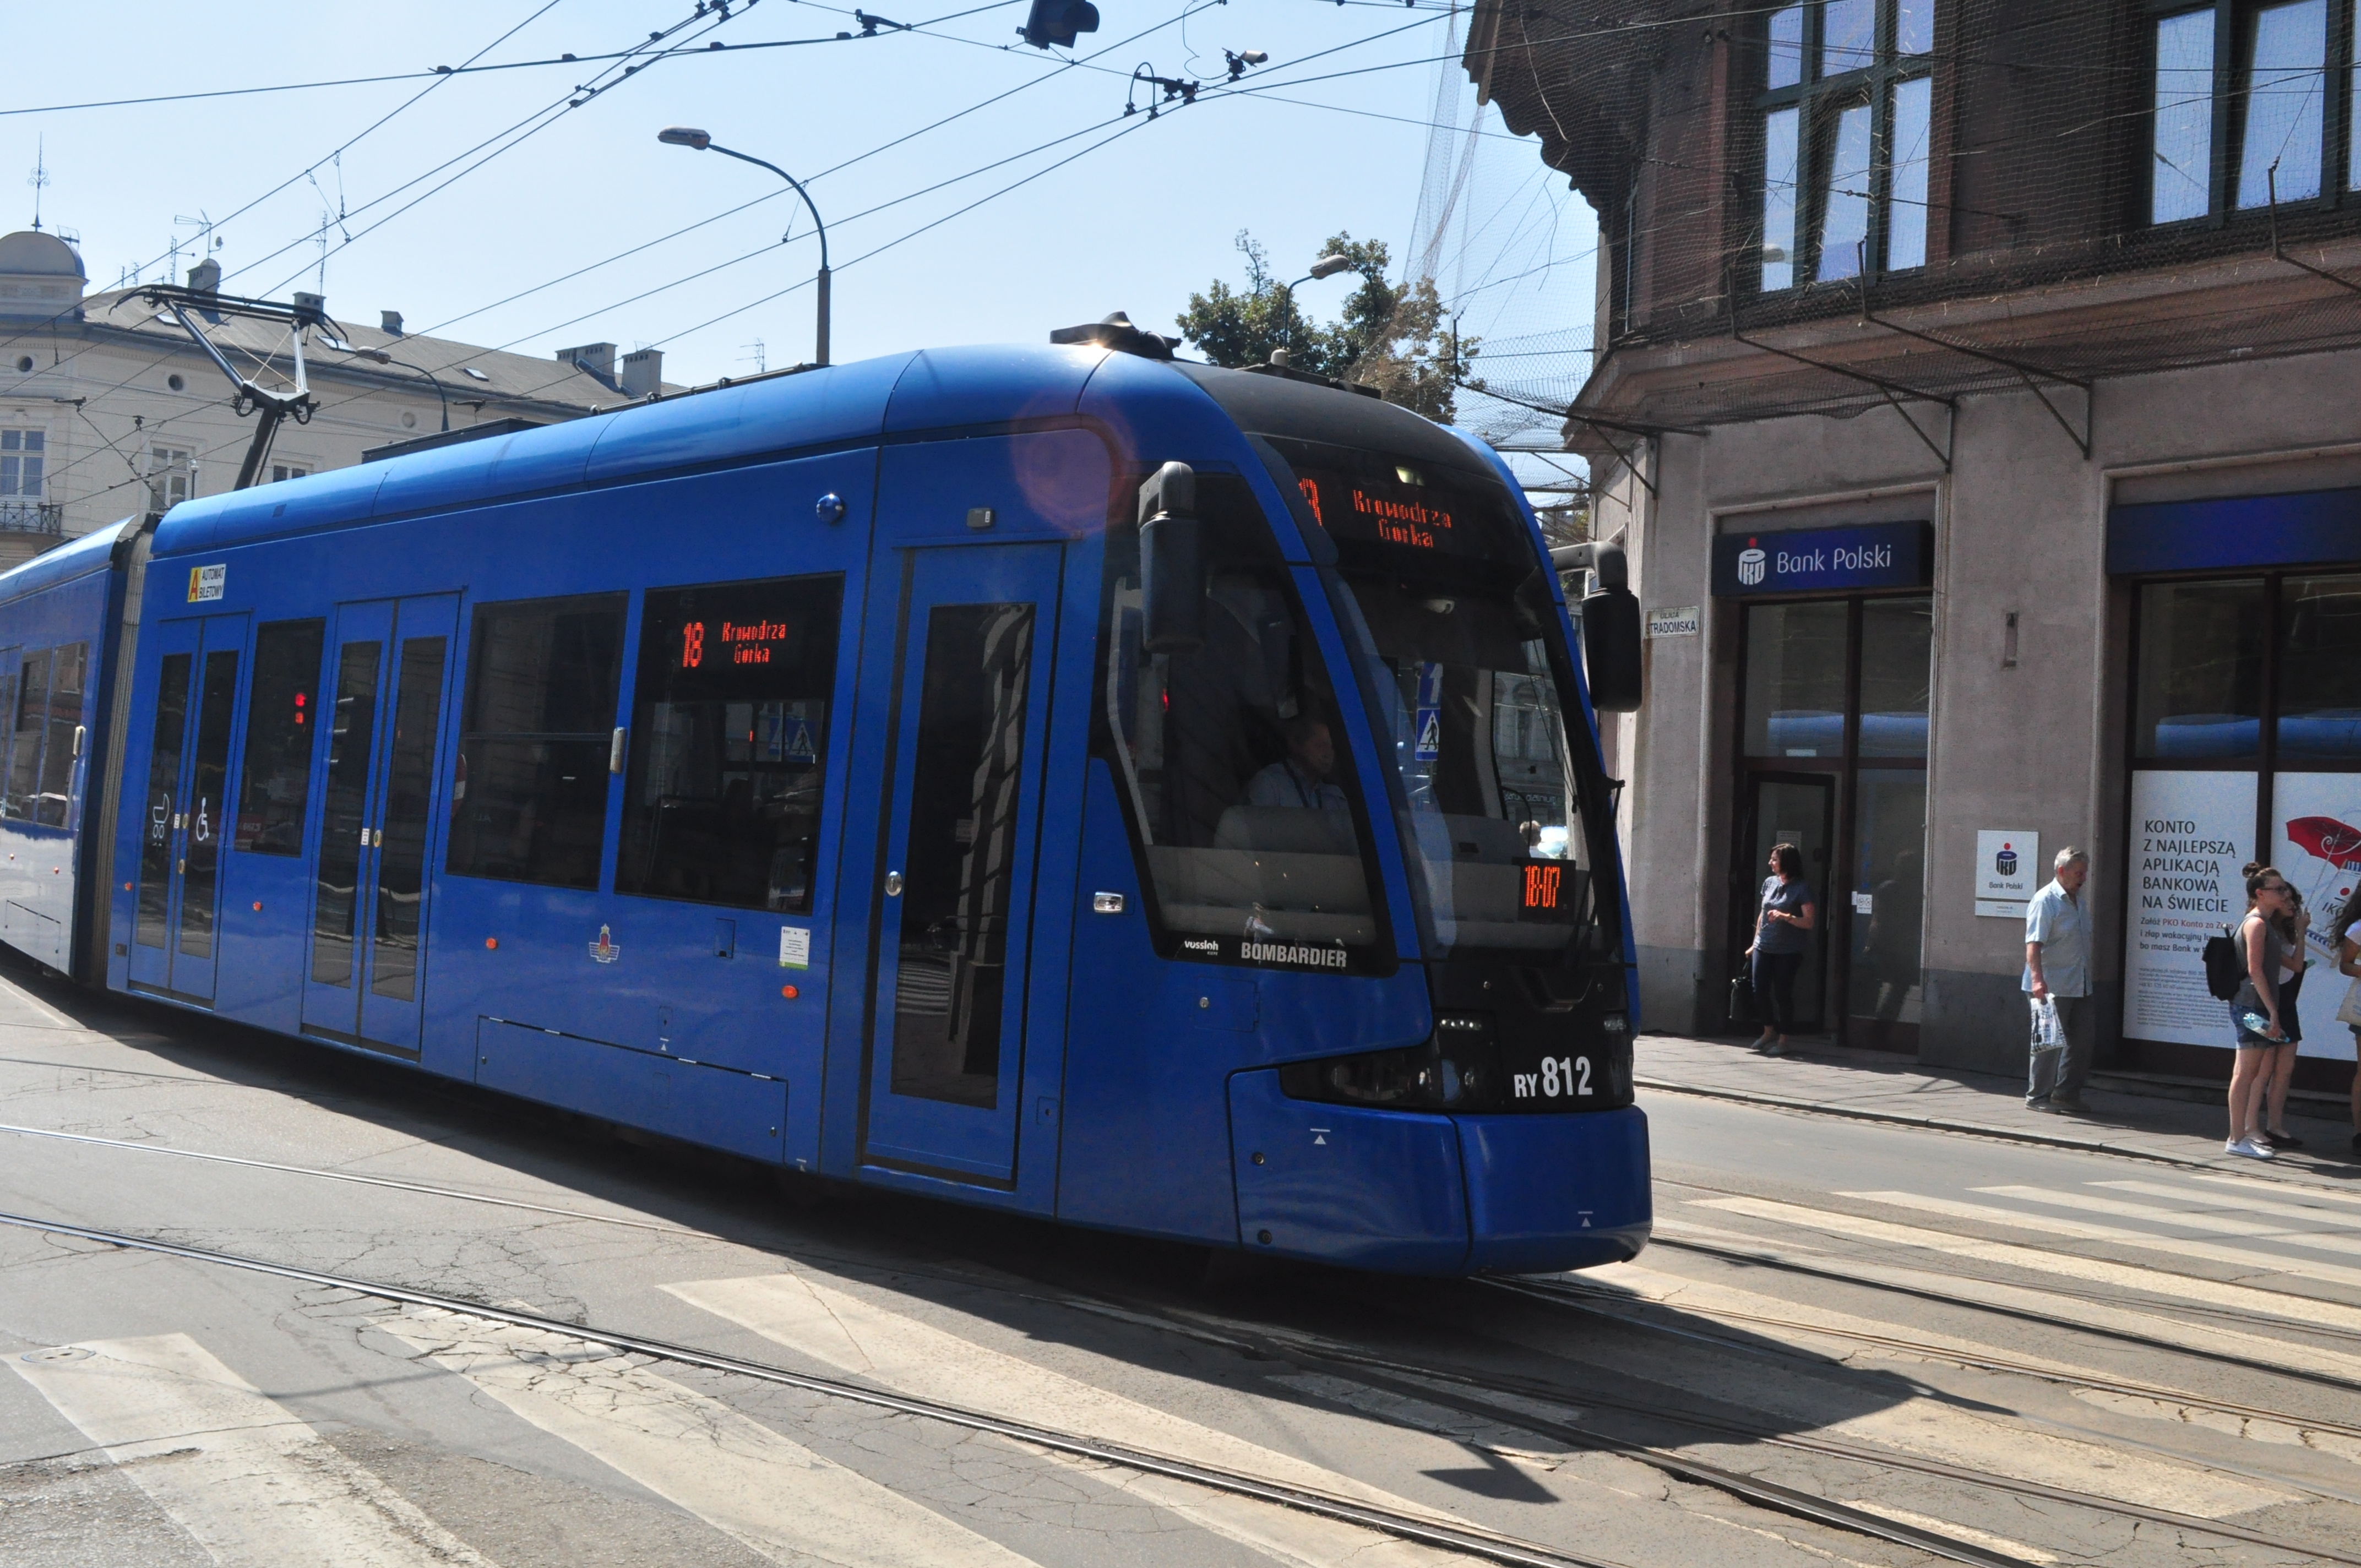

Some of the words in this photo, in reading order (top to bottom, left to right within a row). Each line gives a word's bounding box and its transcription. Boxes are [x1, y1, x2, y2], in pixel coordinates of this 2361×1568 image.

[1777, 548, 1825, 574] Bank
[1834, 544, 1891, 570] Polski
[202, 567, 225, 581] AUTOMAT
[188, 569, 198, 601] A
[199, 585, 223, 598] BILETOWY
[683, 622, 705, 668] 18
[2145, 820, 2196, 834] KONTO
[2144, 839, 2152, 852] Z
[2156, 839, 2237, 859] NAJLEPSZĄ
[2142, 858, 2220, 878] APLIKACJĄ
[2142, 876, 2219, 897] BANKOWĄ
[2142, 895, 2163, 909] NA
[2167, 894, 2229, 913] ŚWIECIE
[2140, 917, 2161, 926] Załóż
[2162, 918, 2179, 927] PKO
[2181, 919, 2203, 928] Konto
[2145, 930, 2160, 939] złap
[2162, 931, 2202, 942] wakacyjny
[1241, 941, 1347, 968] BOMBARDIER
[2172, 944, 2191, 952] Bank
[1514, 1073, 1538, 1097] RY
[1541, 1056, 1593, 1097] 812
